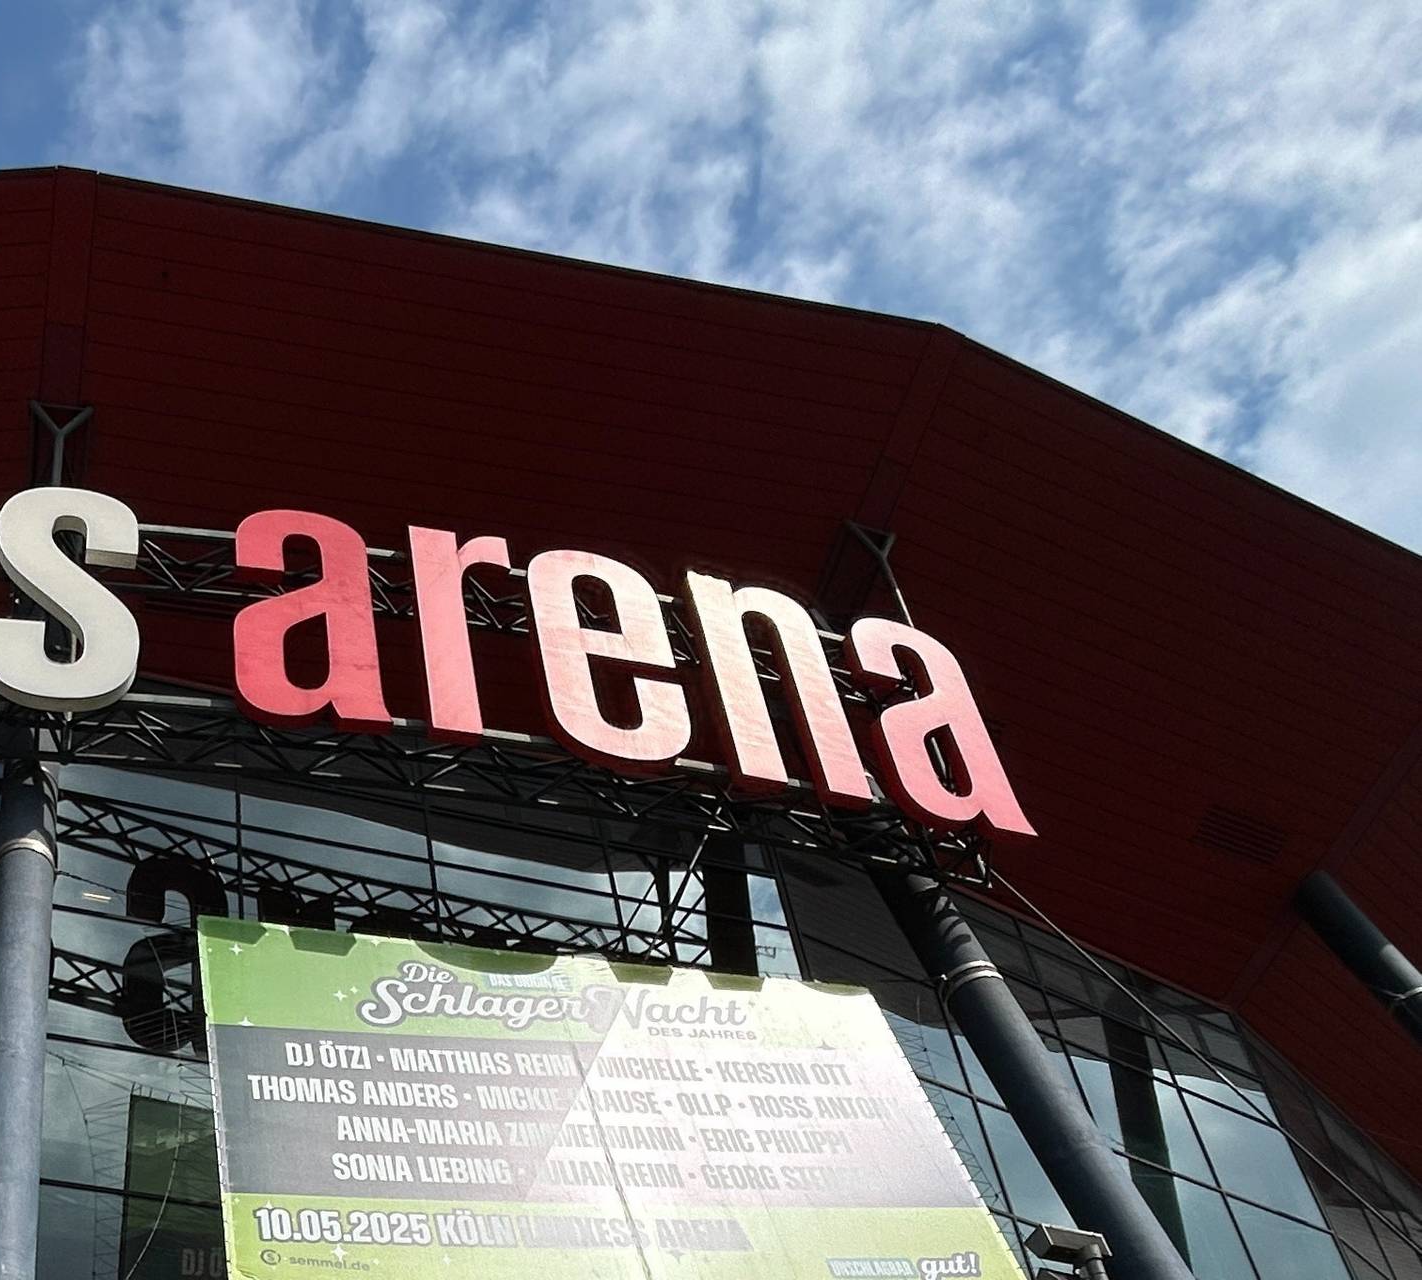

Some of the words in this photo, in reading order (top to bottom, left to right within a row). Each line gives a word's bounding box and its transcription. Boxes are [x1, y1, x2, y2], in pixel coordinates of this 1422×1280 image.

[233, 508, 1037, 838] arena
[401, 962, 455, 984] Die
[359, 979, 590, 1029] Schlager
[584, 984, 747, 1032] Nacht
[647, 1026, 683, 1038] DES
[690, 1028, 757, 1041] JAHRES
[285, 1042, 317, 1067] DJ
[320, 1040, 372, 1070] ÖTZI
[389, 1047, 512, 1076] MATTHIAS
[597, 1056, 702, 1083] MICHELLE
[716, 1060, 808, 1086] KERSTIN
[810, 1063, 853, 1087] OTT
[248, 1074, 356, 1105] THOMAS
[363, 1080, 459, 1109] ANDERS
[750, 1095, 813, 1119] ROSS
[337, 1115, 503, 1147] ANNA-MARIA
[701, 1128, 755, 1153] ERIC
[756, 1130, 854, 1155] PHILIPPI
[332, 1153, 412, 1183] SONIA
[417, 1156, 513, 1185] LIEBING
[619, 1163, 684, 1189] REIM
[700, 1164, 781, 1191] GEORG
[256, 1207, 433, 1245] 10.05.2025
[435, 1209, 518, 1247] KÖLN
[289, 1256, 371, 1272] semmel.de
[919, 1252, 979, 1280] gut!
